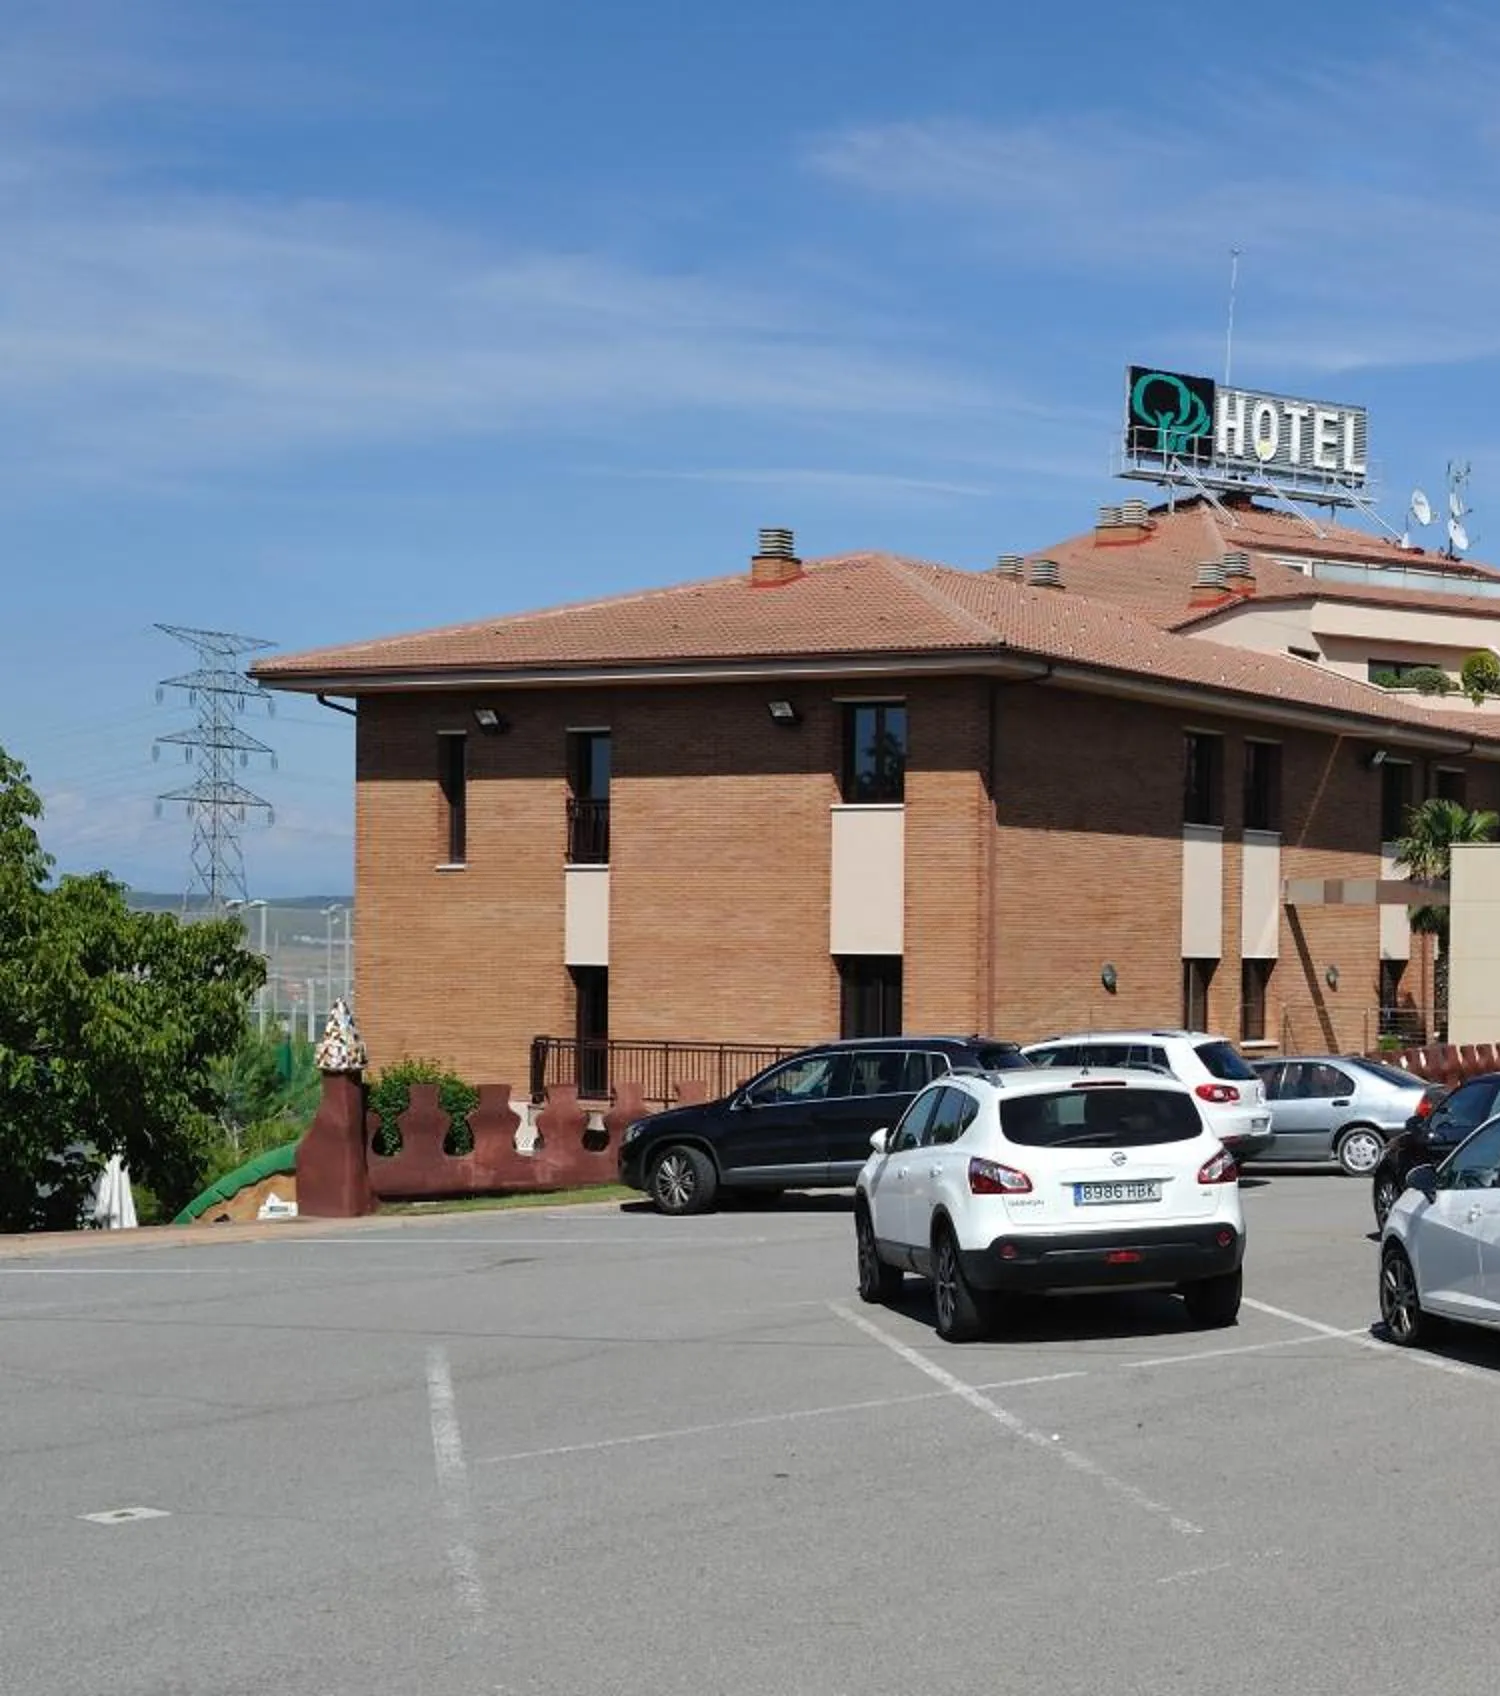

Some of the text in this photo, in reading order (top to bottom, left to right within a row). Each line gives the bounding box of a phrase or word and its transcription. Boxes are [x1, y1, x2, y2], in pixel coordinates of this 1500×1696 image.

[1216, 391, 1367, 474] HOTEL
[1083, 1183, 1156, 1200] 8986 HBK
